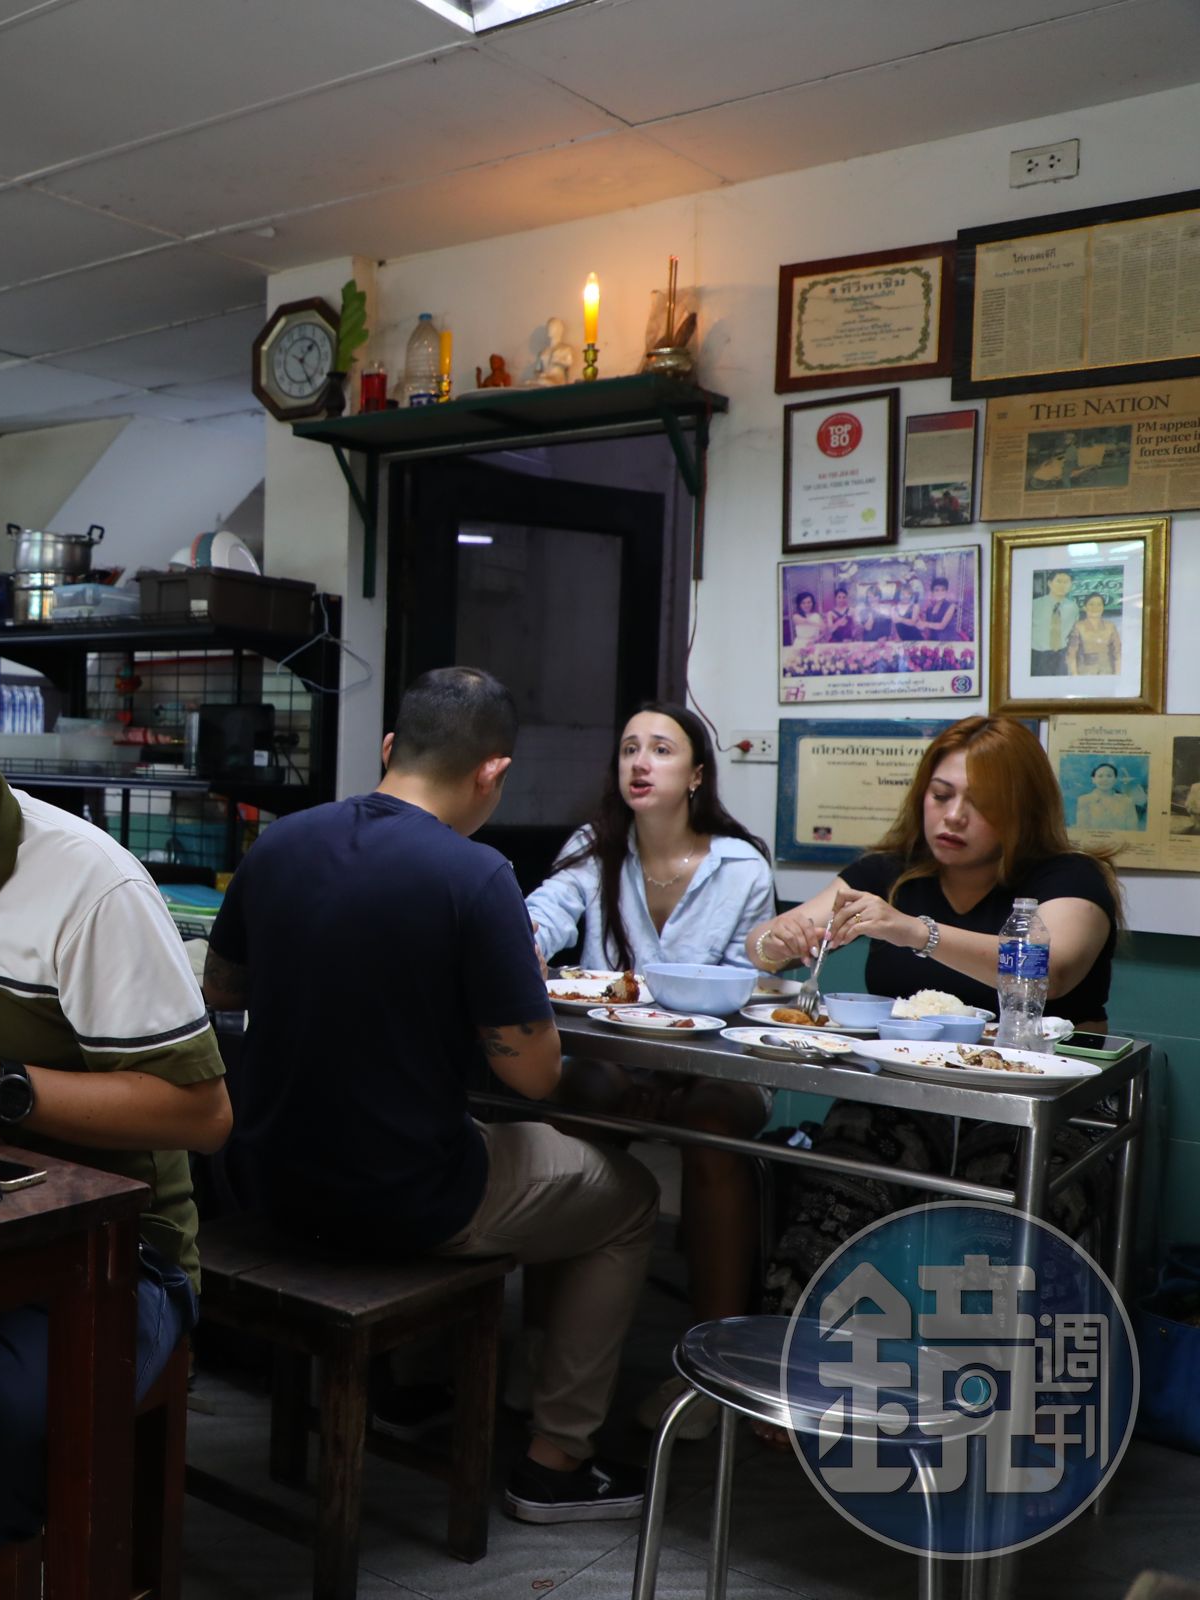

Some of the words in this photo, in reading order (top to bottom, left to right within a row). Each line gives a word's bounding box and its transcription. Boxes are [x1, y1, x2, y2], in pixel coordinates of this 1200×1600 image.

[1029, 402, 1077, 421] THE
[1084, 394, 1171, 417] NATION
[827, 423, 853, 436] TOP
[1136, 420, 1157, 433] PM
[830, 433, 850, 448] 80
[1136, 434, 1155, 445] for
[1155, 431, 1192, 448] peace
[1139, 444, 1171, 457] forex
